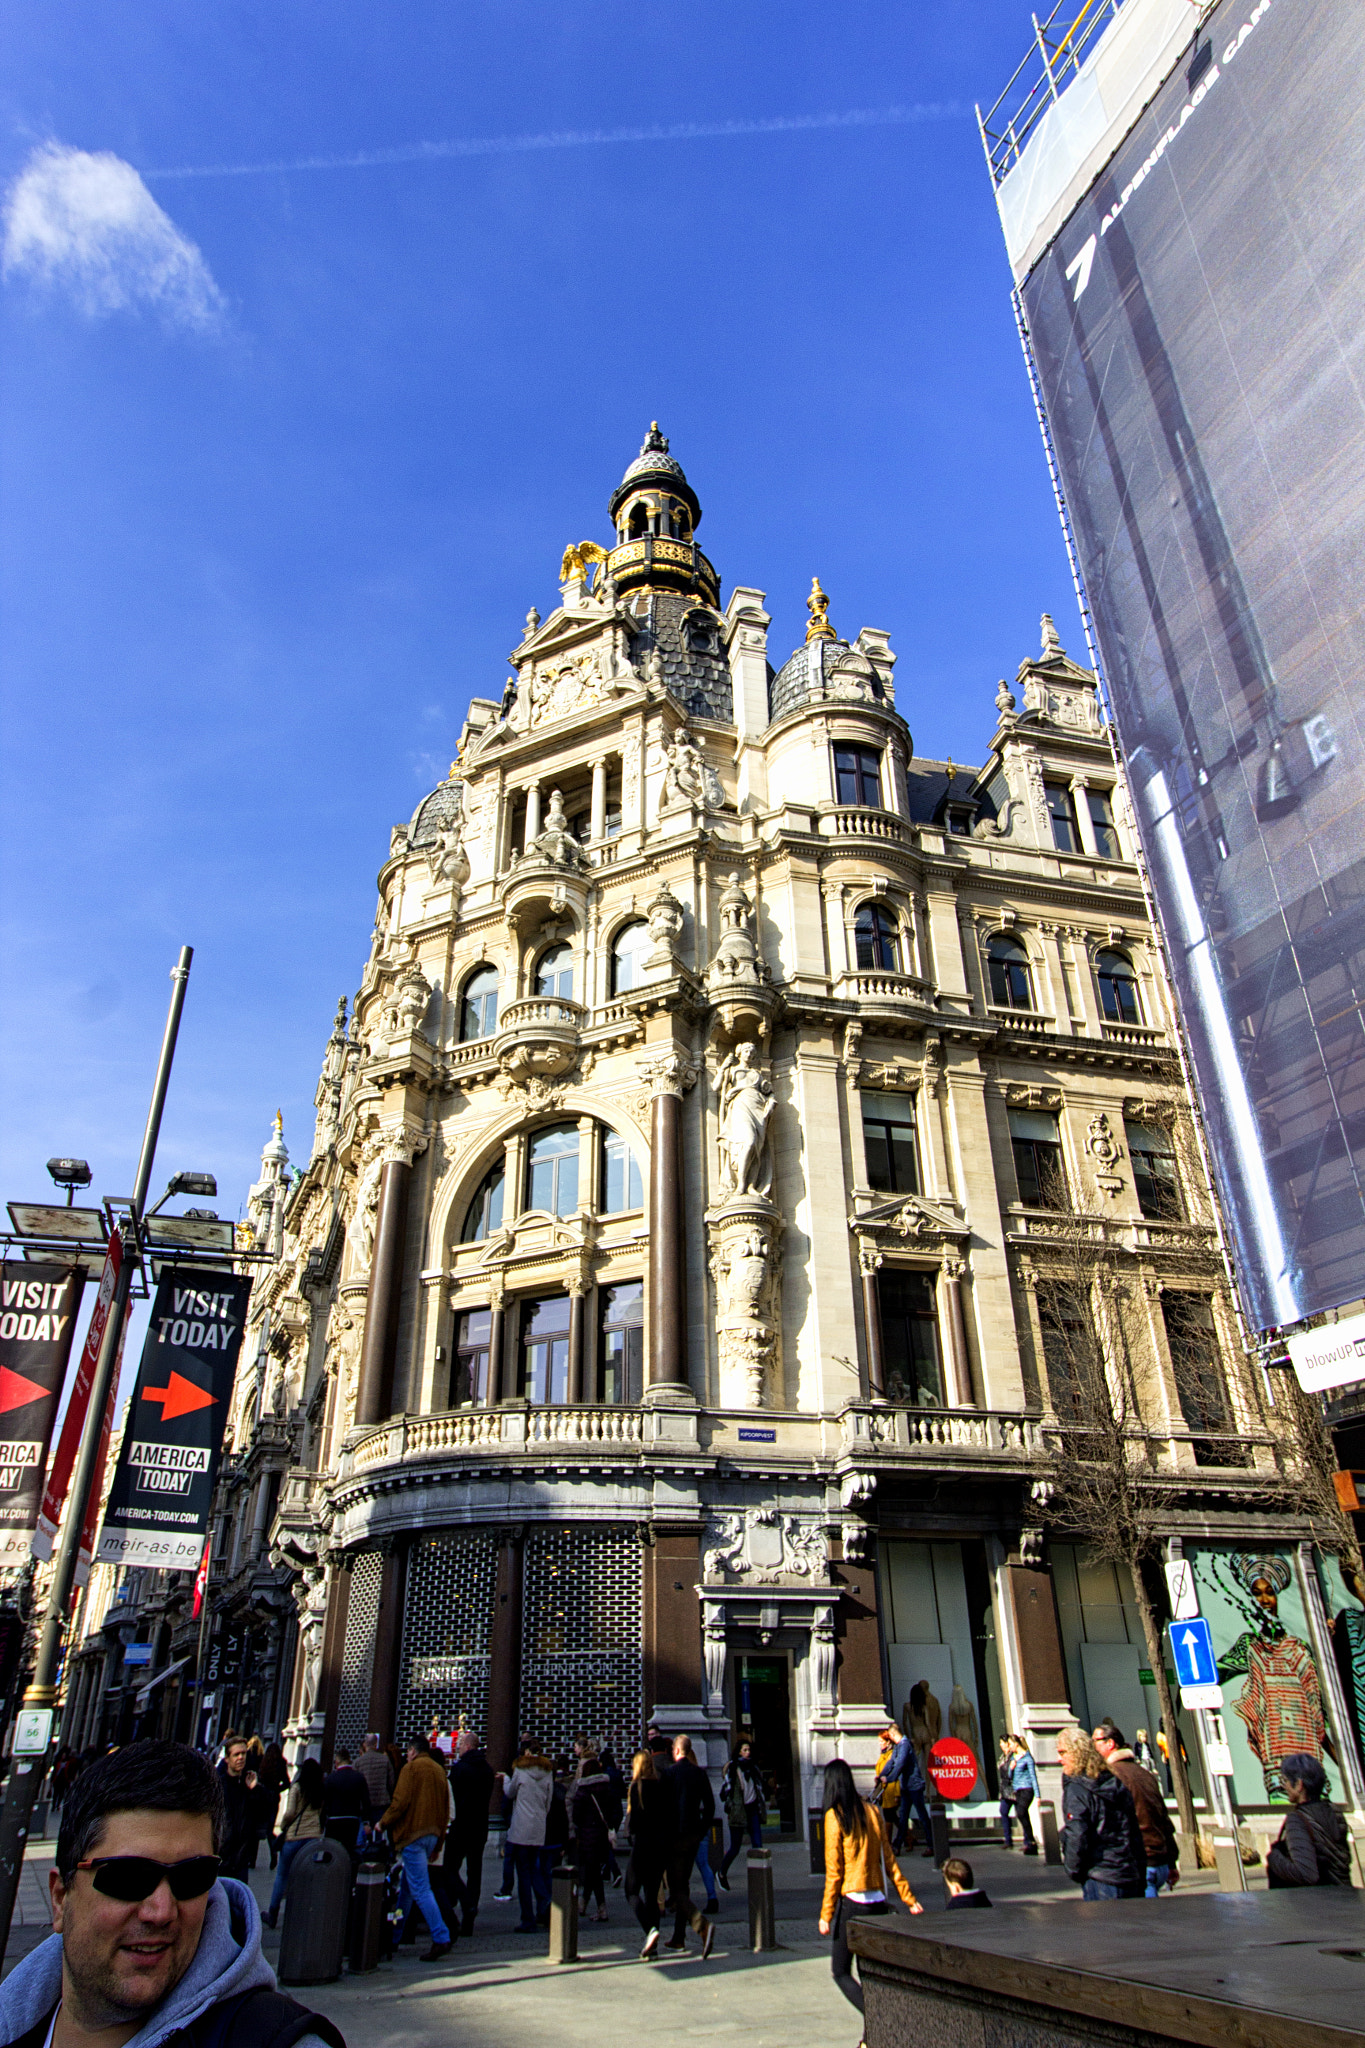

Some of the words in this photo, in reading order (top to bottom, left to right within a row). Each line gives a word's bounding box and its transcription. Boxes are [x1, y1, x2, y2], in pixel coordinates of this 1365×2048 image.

[1065, 233, 1097, 302] 7
[1101, 64, 1221, 237] ALPENFLAGE
[3, 1281, 68, 1310] VISIT
[174, 1287, 235, 1319] VISIT
[0, 1312, 69, 1341] ODAY
[158, 1316, 236, 1350] TODAY
[1305, 1344, 1353, 1369] blowUP
[0, 1444, 37, 1463] RICA
[131, 1445, 205, 1469] AMERICA
[142, 1469, 190, 1492] TODAY
[114, 1507, 200, 1524] AMERICA-TODAY.COM
[103, 1537, 197, 1556] meir-as.be
[208, 1643, 222, 1681] ONLY
[26, 1728, 39, 1737] 56
[934, 1755, 970, 1766] RONDE
[931, 1768, 974, 1779] PRIJZEN
